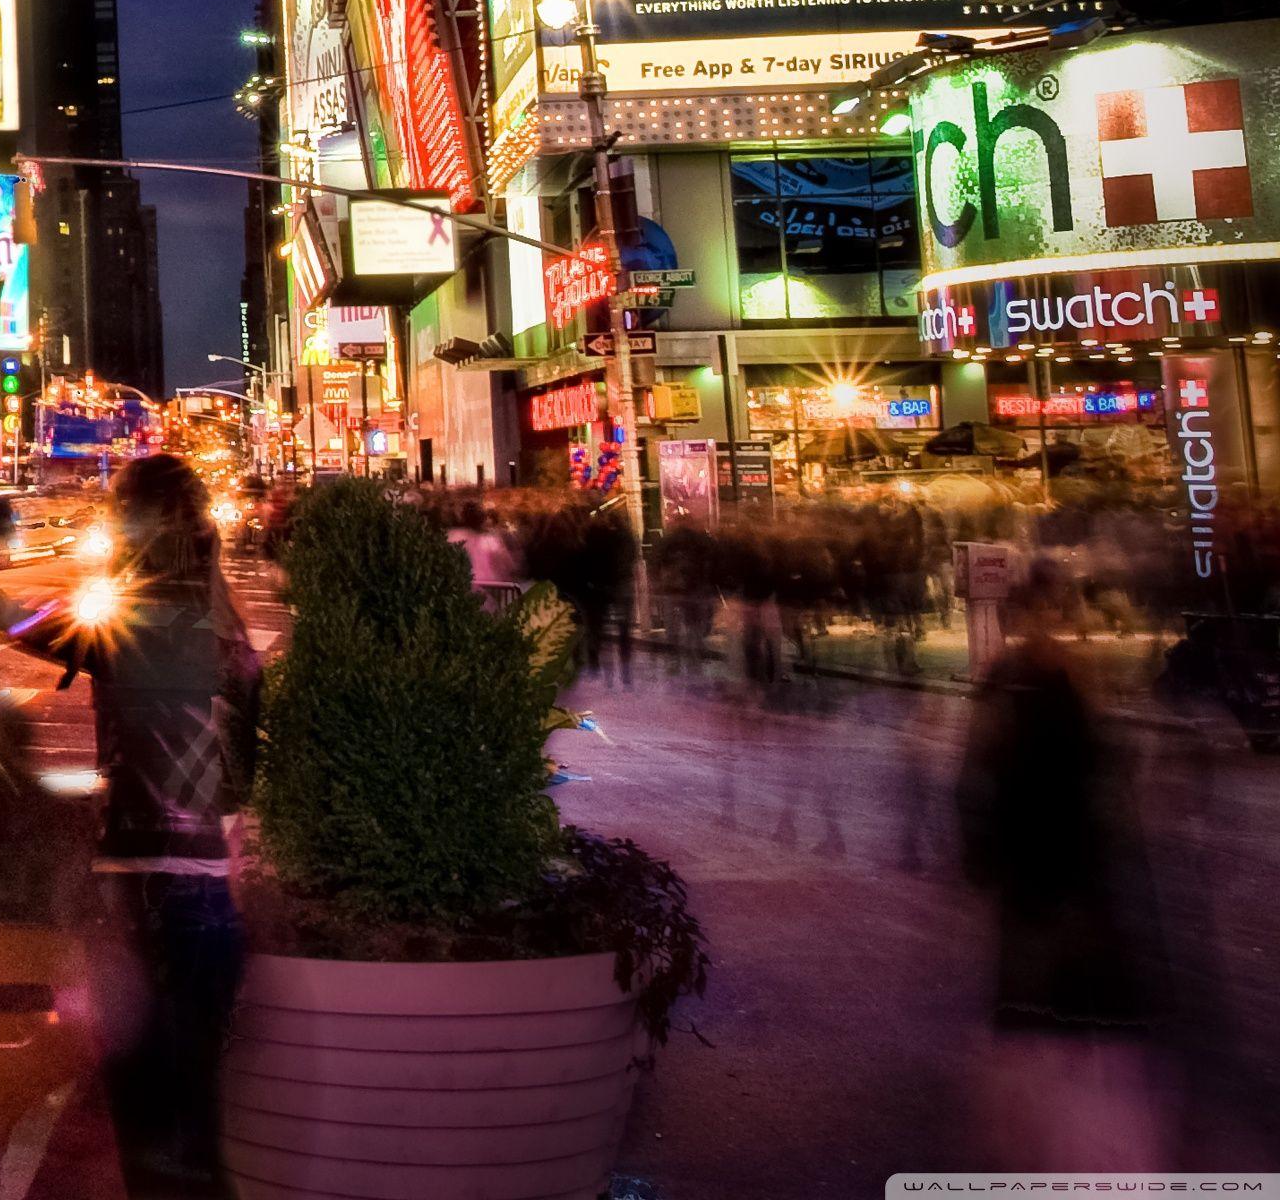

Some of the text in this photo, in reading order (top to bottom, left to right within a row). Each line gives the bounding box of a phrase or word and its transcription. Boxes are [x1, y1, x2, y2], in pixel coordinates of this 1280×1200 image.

[641, 59, 685, 78] Free
[693, 57, 735, 81] App
[741, 57, 756, 74] &
[762, 53, 822, 78] 7-day
[1006, 282, 1178, 333] swatch
[902, 400, 930, 416] BAR
